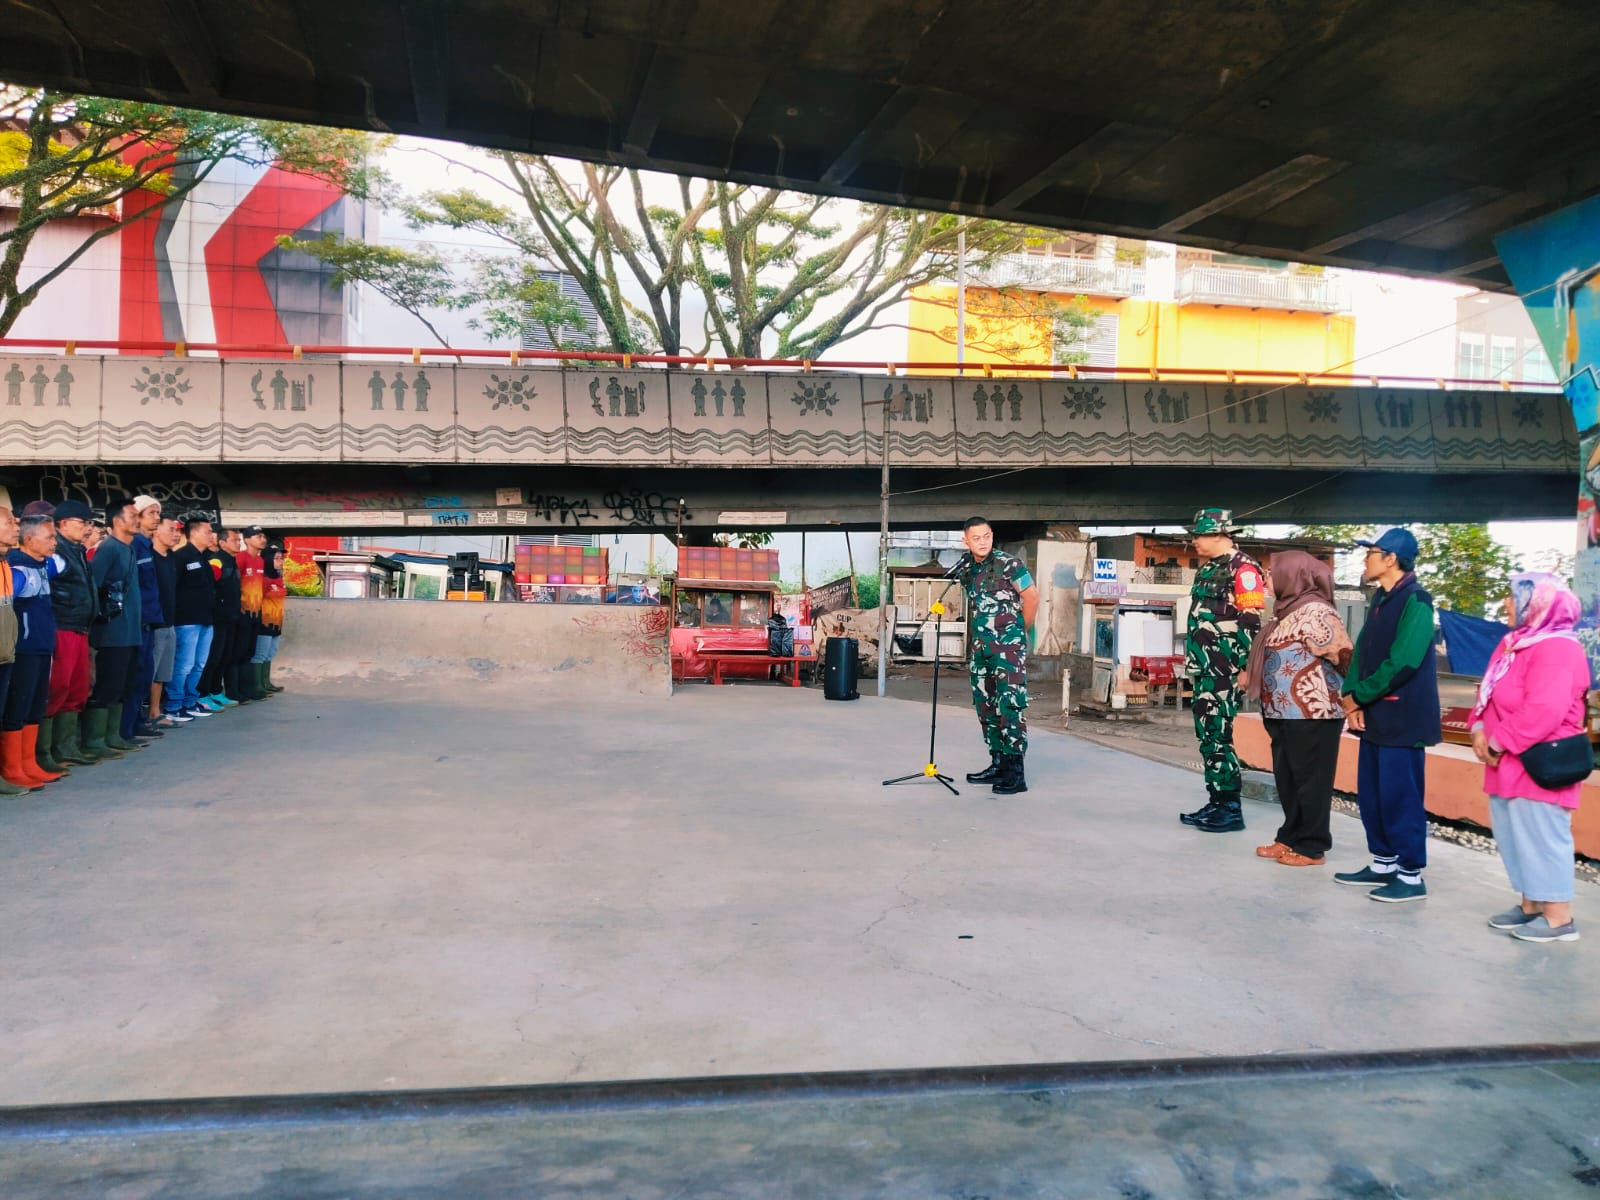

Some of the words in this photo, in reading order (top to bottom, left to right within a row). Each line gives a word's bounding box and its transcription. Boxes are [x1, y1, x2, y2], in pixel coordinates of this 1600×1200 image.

[1097, 561, 1113, 570] WC
[1088, 583, 1105, 595] WC
[836, 614, 852, 623] CUP
